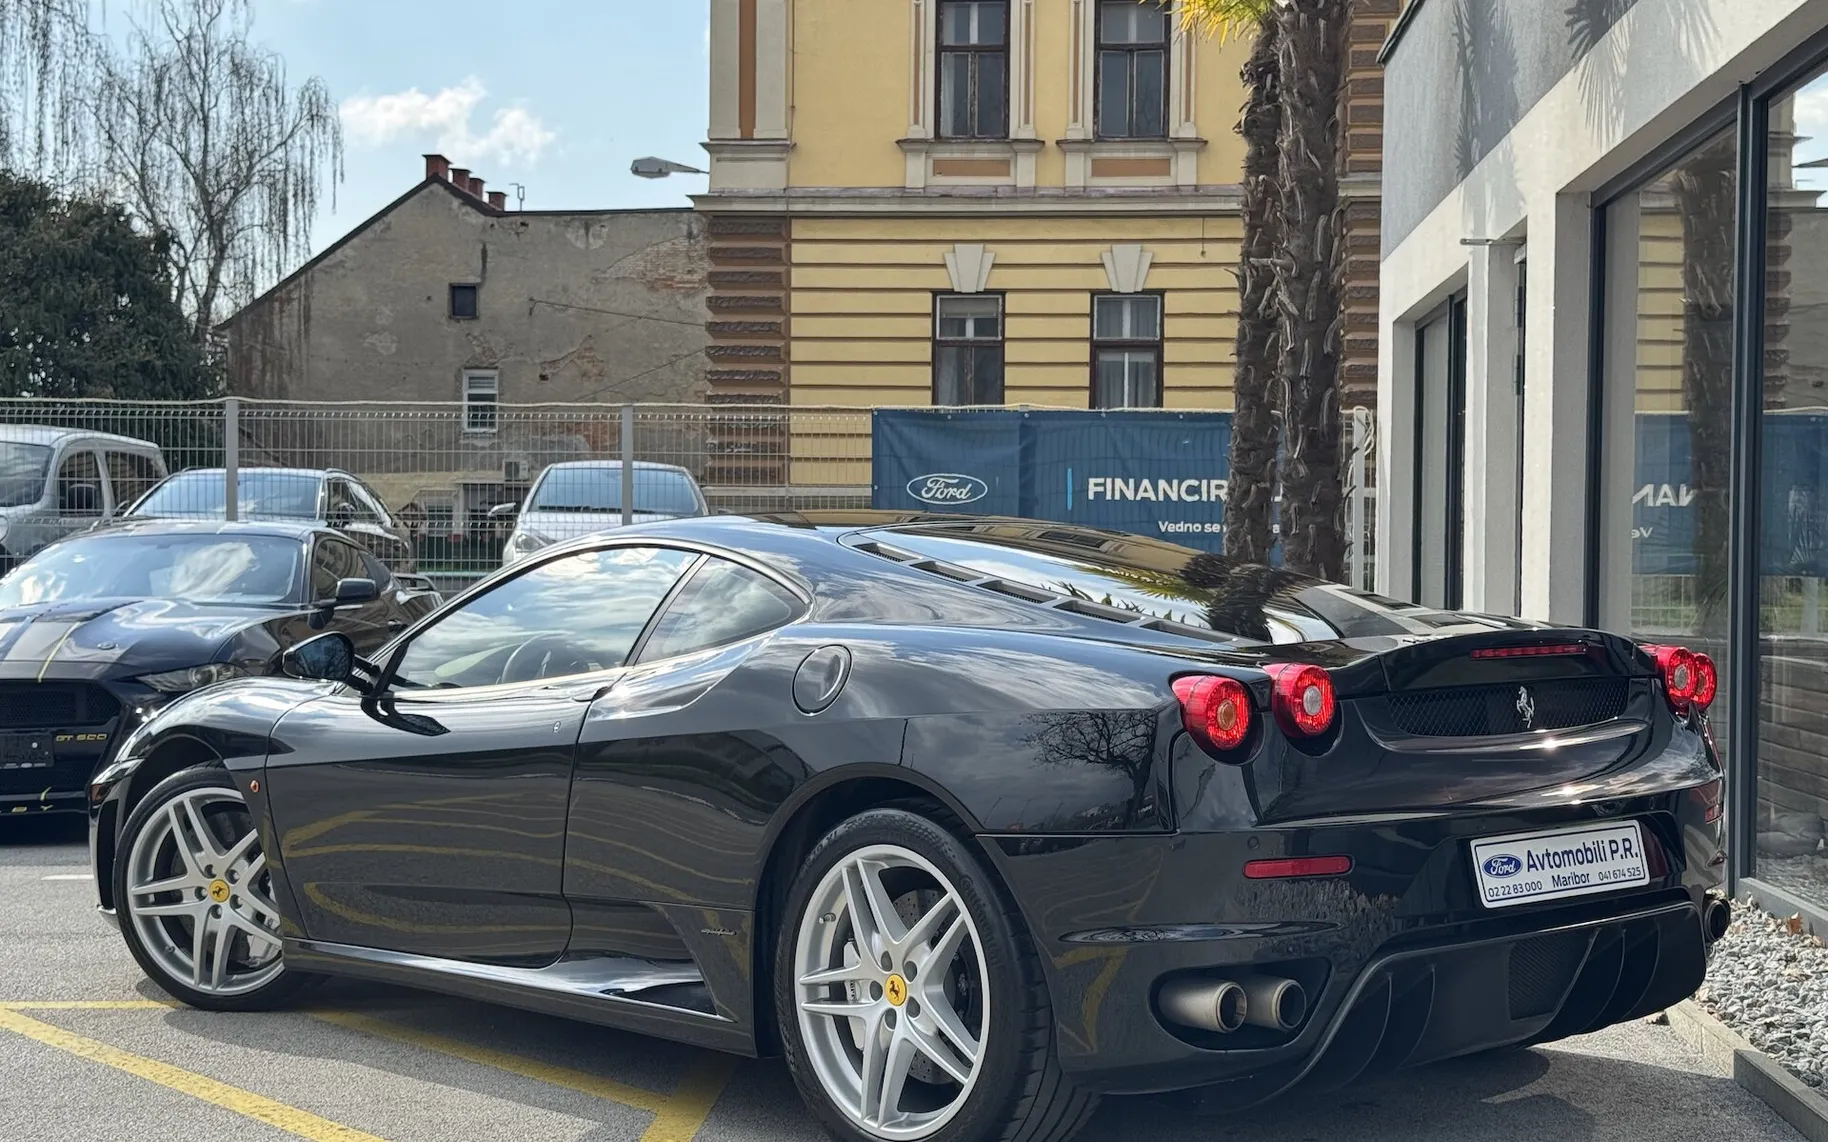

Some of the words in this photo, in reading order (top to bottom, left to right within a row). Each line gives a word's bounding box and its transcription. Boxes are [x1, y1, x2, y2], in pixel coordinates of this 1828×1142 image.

[921, 477, 972, 500] Ford
[1087, 478, 1283, 502] FINANCIR
[1158, 521, 1202, 533] Vedno
[1204, 524, 1220, 533] se
[1526, 840, 1608, 872] Avtomobili
[1609, 837, 1639, 861] P.R.
[1490, 857, 1517, 874] Ford
[1598, 871, 1612, 882] 041
[1612, 869, 1627, 879] 674
[1627, 866, 1642, 877] 525
[1488, 886, 1500, 898] 02
[1501, 884, 1512, 895] 22
[1513, 883, 1524, 894] 83
[1525, 880, 1543, 893] 000
[1551, 872, 1590, 889] Maribor
